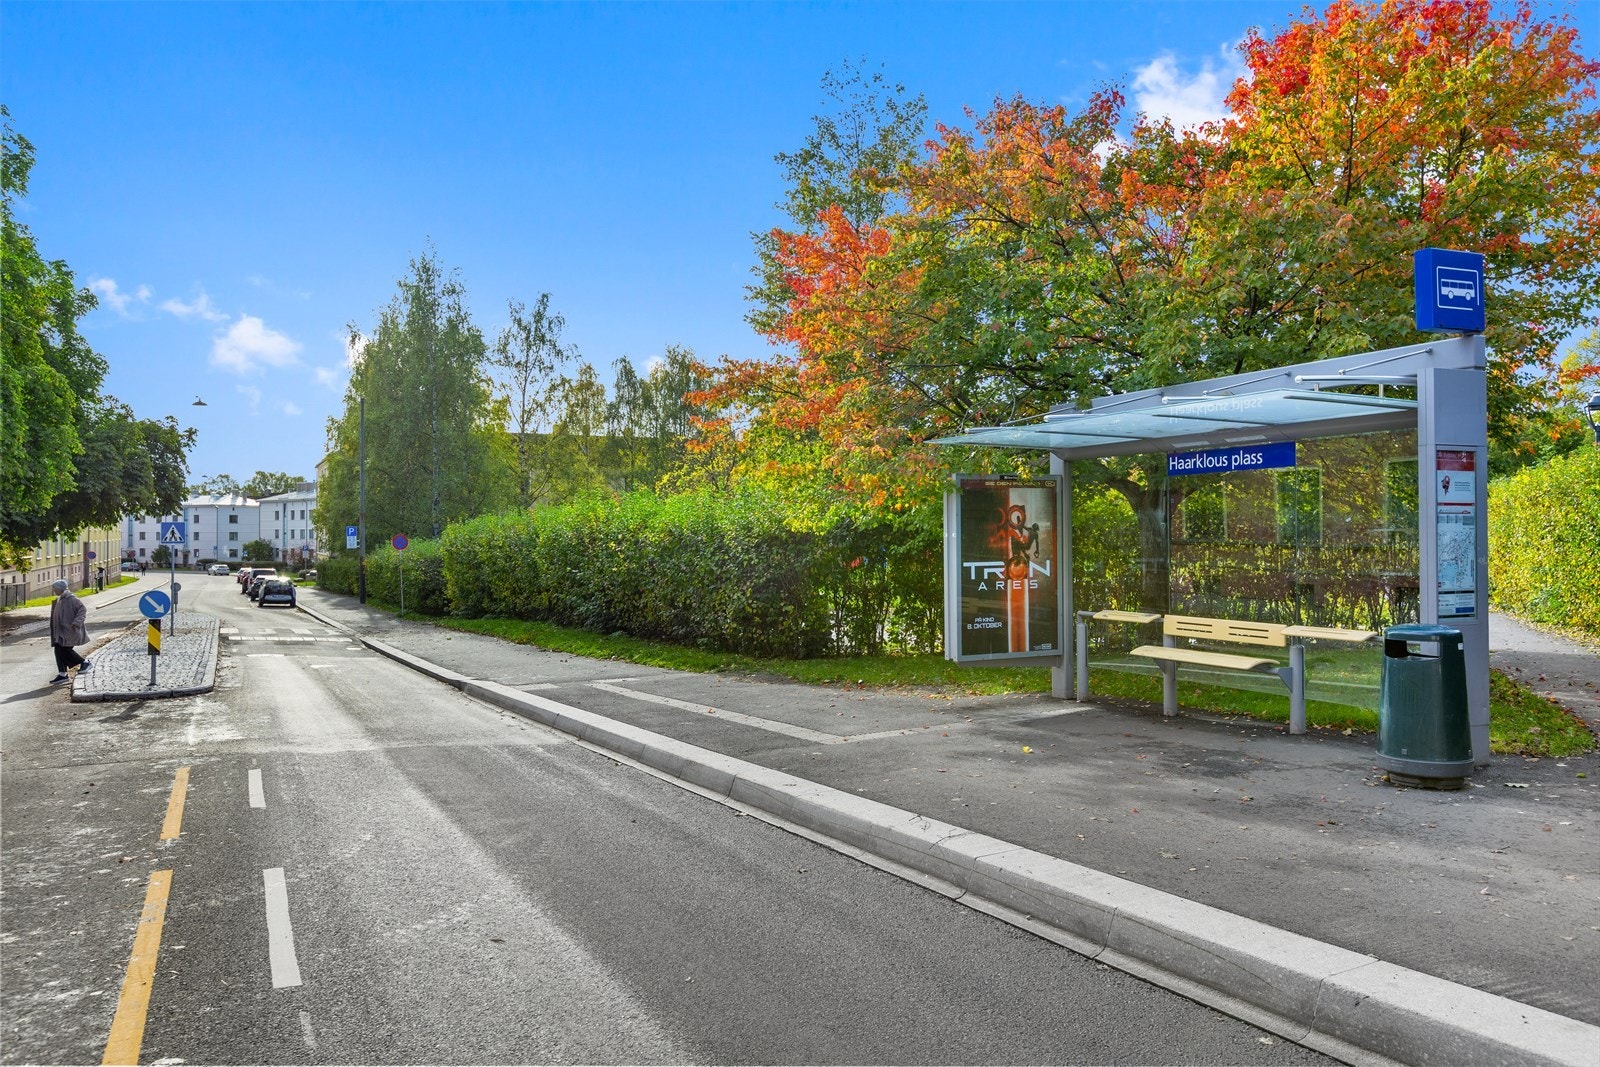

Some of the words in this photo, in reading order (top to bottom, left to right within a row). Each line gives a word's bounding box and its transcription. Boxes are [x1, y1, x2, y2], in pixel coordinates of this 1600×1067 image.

[1169, 453, 1228, 471] Haarklous
[1231, 450, 1263, 470] plass
[963, 560, 1051, 580] TRON
[978, 580, 1038, 591] ARES
[974, 621, 1003, 629] OKTOBER
